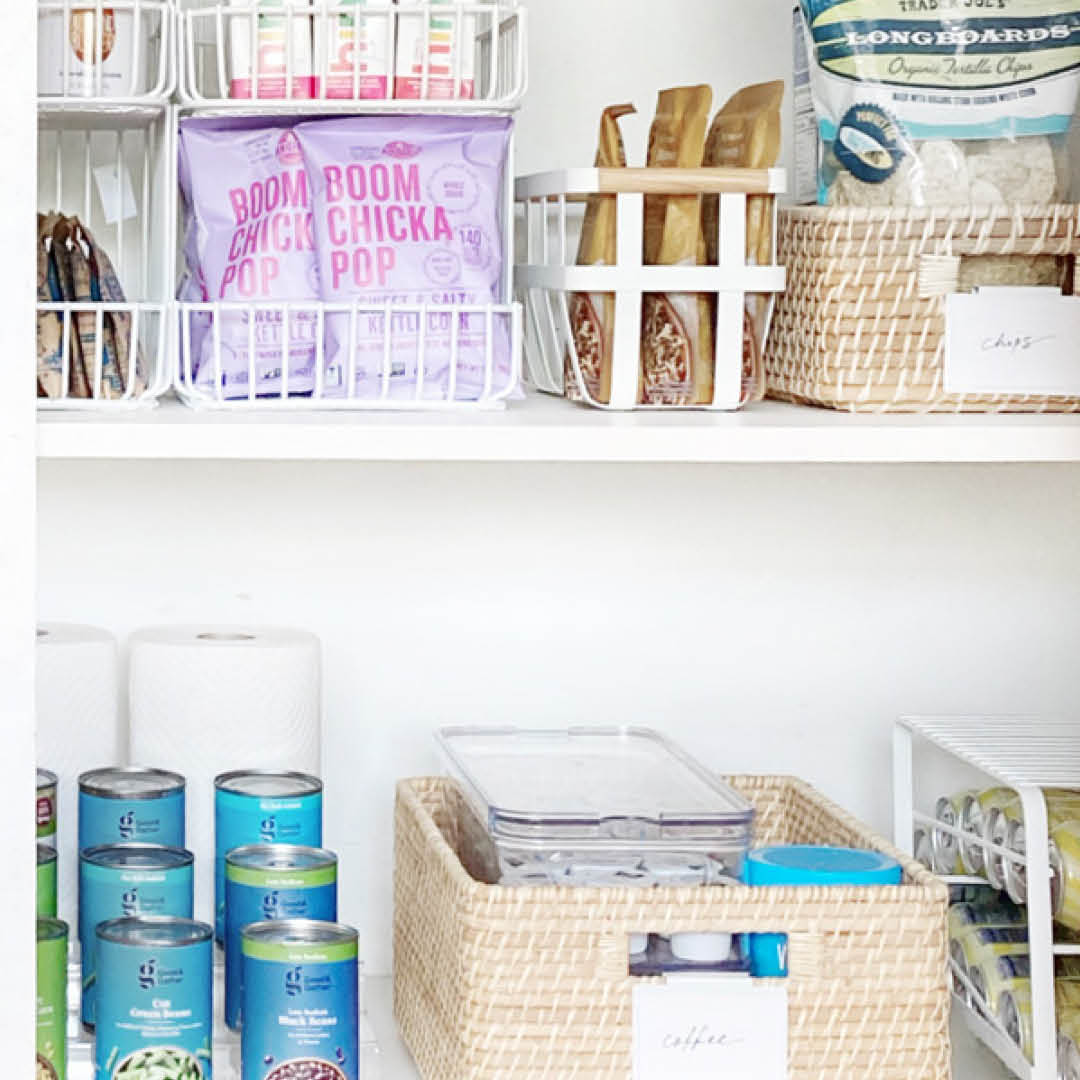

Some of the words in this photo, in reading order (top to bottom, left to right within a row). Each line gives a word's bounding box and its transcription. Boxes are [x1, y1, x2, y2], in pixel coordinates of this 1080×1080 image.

[846, 25, 1070, 46] LONGBOARDS
[888, 56, 938, 79] Organic
[229, 169, 307, 227] BOOM
[323, 163, 421, 203] BOOM
[228, 212, 314, 262] CHICK
[327, 204, 453, 246] CHICKA
[219, 256, 279, 299] POP
[331, 246, 396, 290] POP
[662, 1025, 745, 1051] coffee
